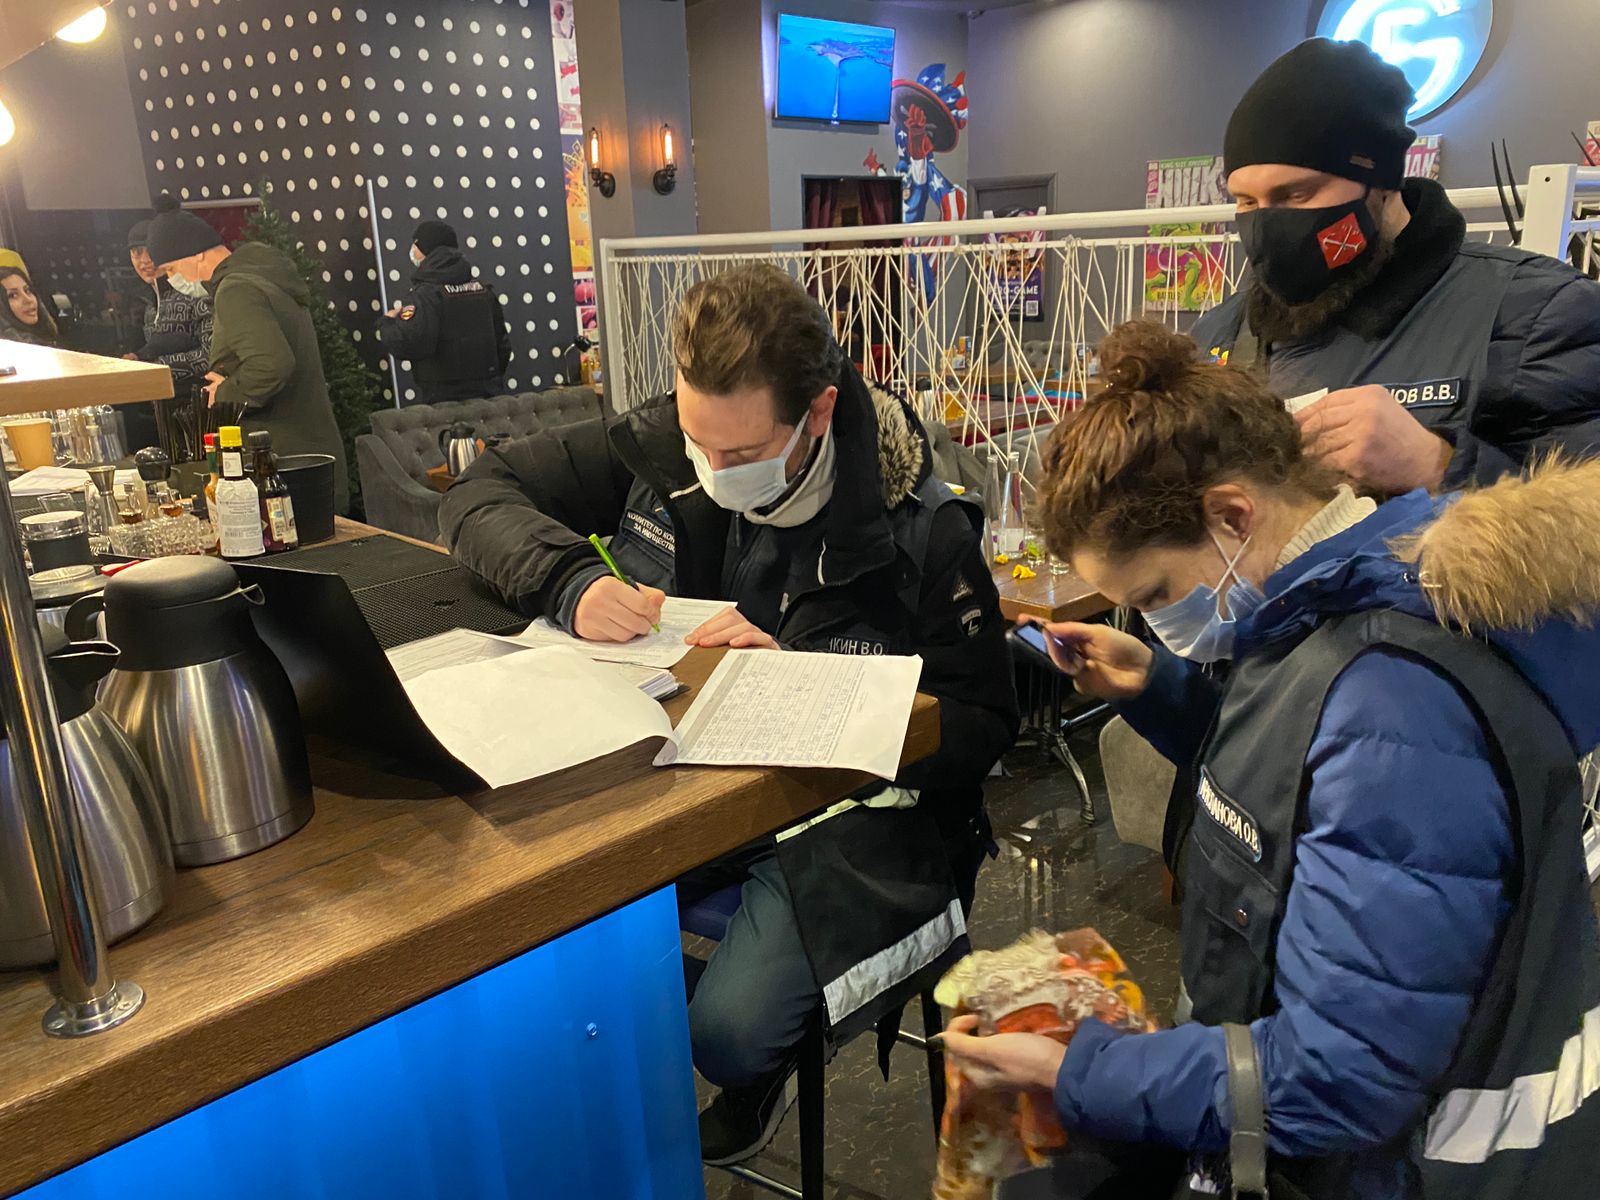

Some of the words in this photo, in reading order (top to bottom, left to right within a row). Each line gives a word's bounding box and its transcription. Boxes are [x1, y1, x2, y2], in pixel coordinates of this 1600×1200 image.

[1422, 384, 1455, 401] В.В.
[633, 522, 643, 533] ЗА
[652, 525, 663, 536] ПО
